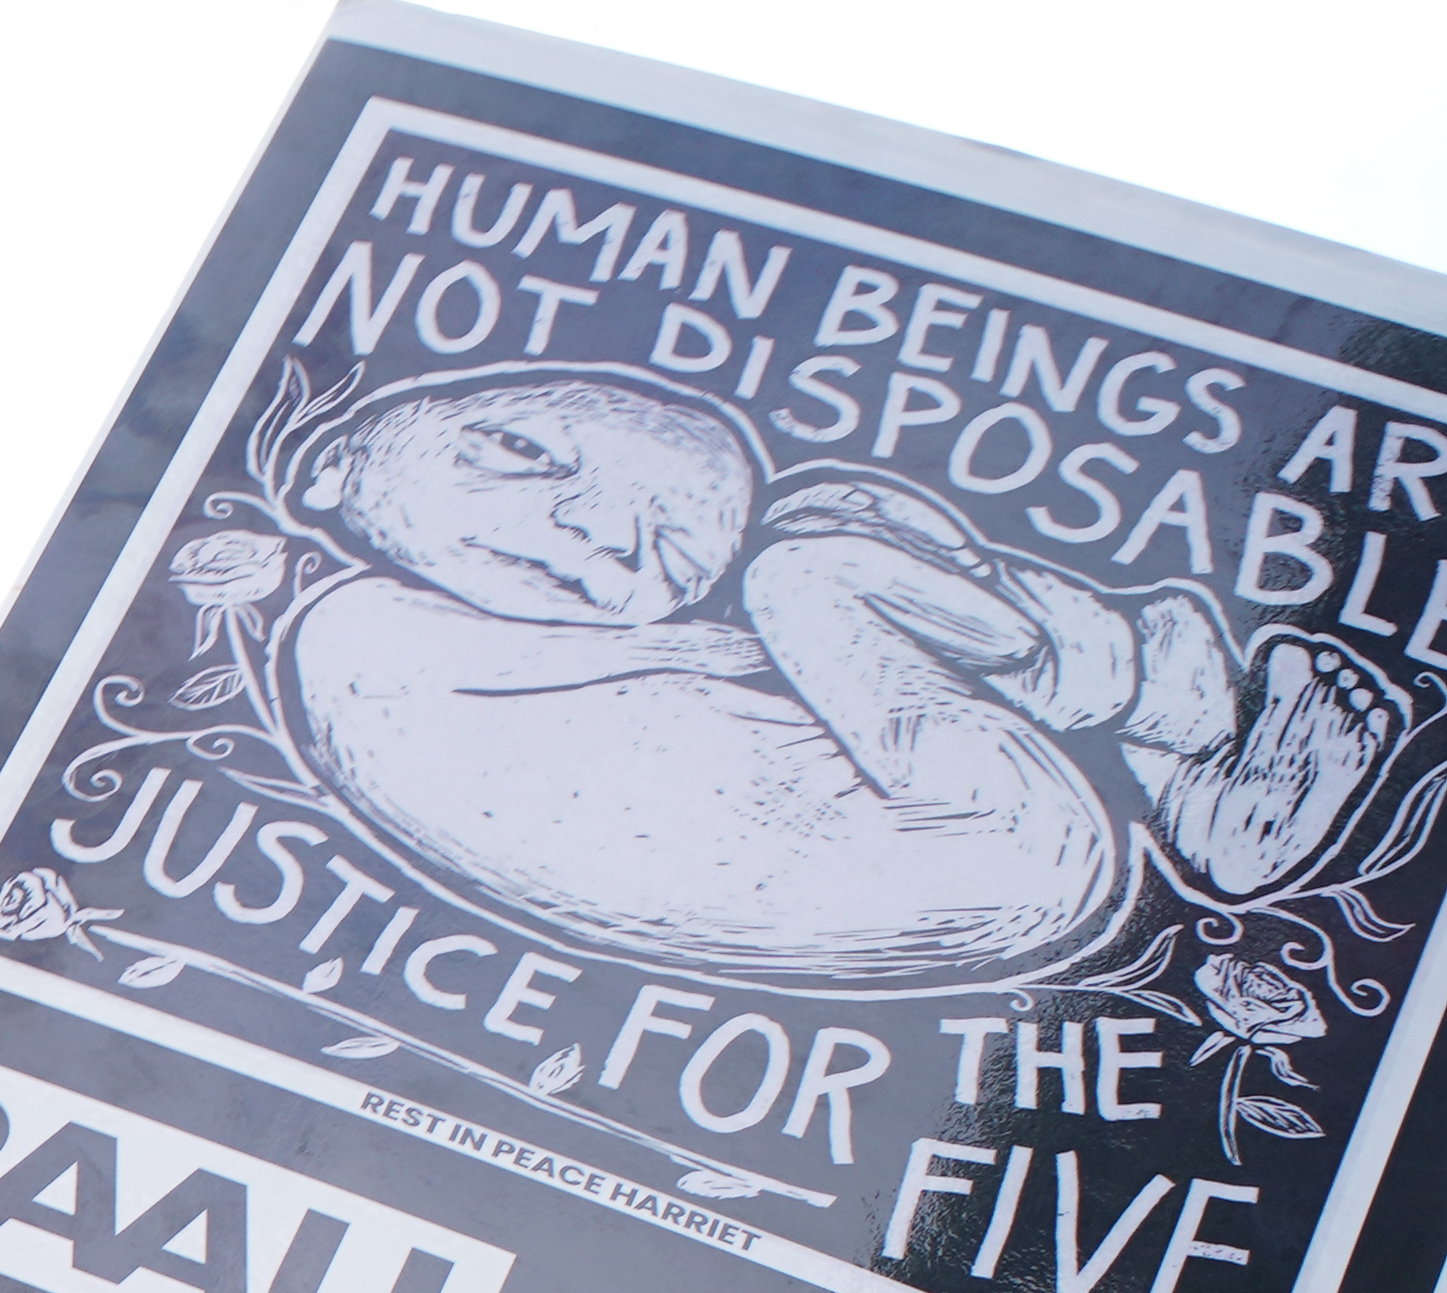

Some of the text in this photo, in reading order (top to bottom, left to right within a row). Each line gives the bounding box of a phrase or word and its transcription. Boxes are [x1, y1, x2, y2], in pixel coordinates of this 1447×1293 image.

[294, 239, 599, 357] NOT
[371, 156, 791, 319] HUMAN
[816, 265, 1247, 455] BEINGS
[49, 766, 1164, 1166] JUSTICE FOR THE
[360, 1091, 762, 1252] REST IN PEACE HARRIET
